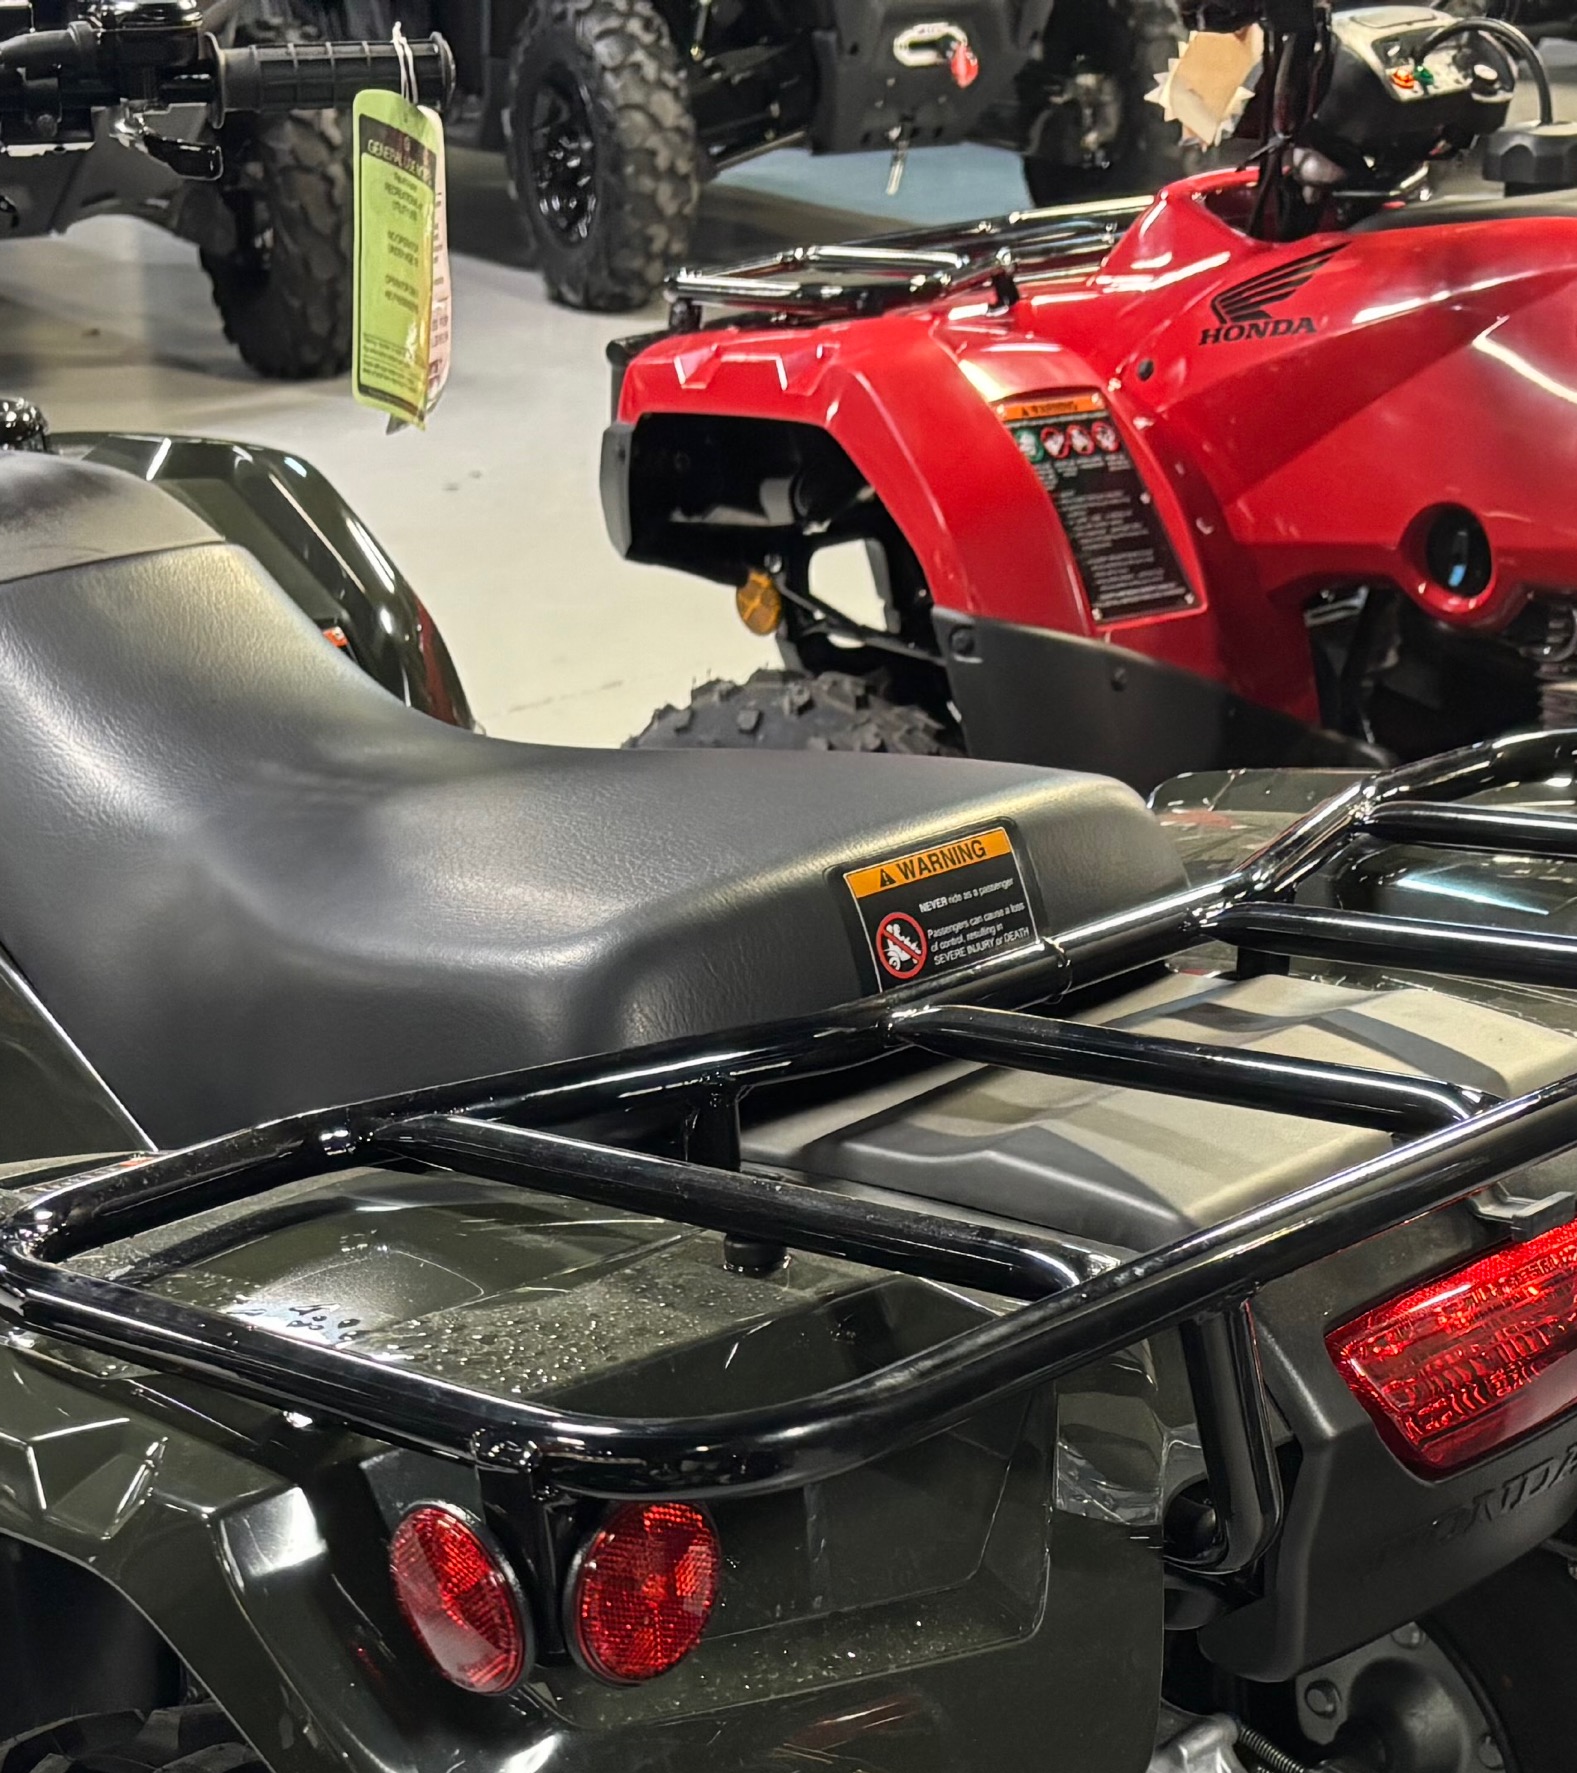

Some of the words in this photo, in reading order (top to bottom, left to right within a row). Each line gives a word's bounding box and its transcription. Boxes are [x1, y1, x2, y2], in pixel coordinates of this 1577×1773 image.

[1198, 316, 1318, 346] HONDA
[897, 839, 986, 881] WARNING
[919, 897, 947, 912] NEVER
[948, 893, 961, 903] ride
[963, 891, 971, 899] as
[979, 878, 1013, 896] passenger
[927, 918, 969, 940] Passengers
[969, 916, 982, 925] can
[983, 909, 1003, 921] cause
[1010, 901, 1024, 912] loss
[930, 943, 938, 951] of
[966, 925, 996, 943] resulting
[933, 946, 969, 964] SEVERE
[967, 938, 994, 953] INJURY
[1003, 927, 1029, 942] DEATH
